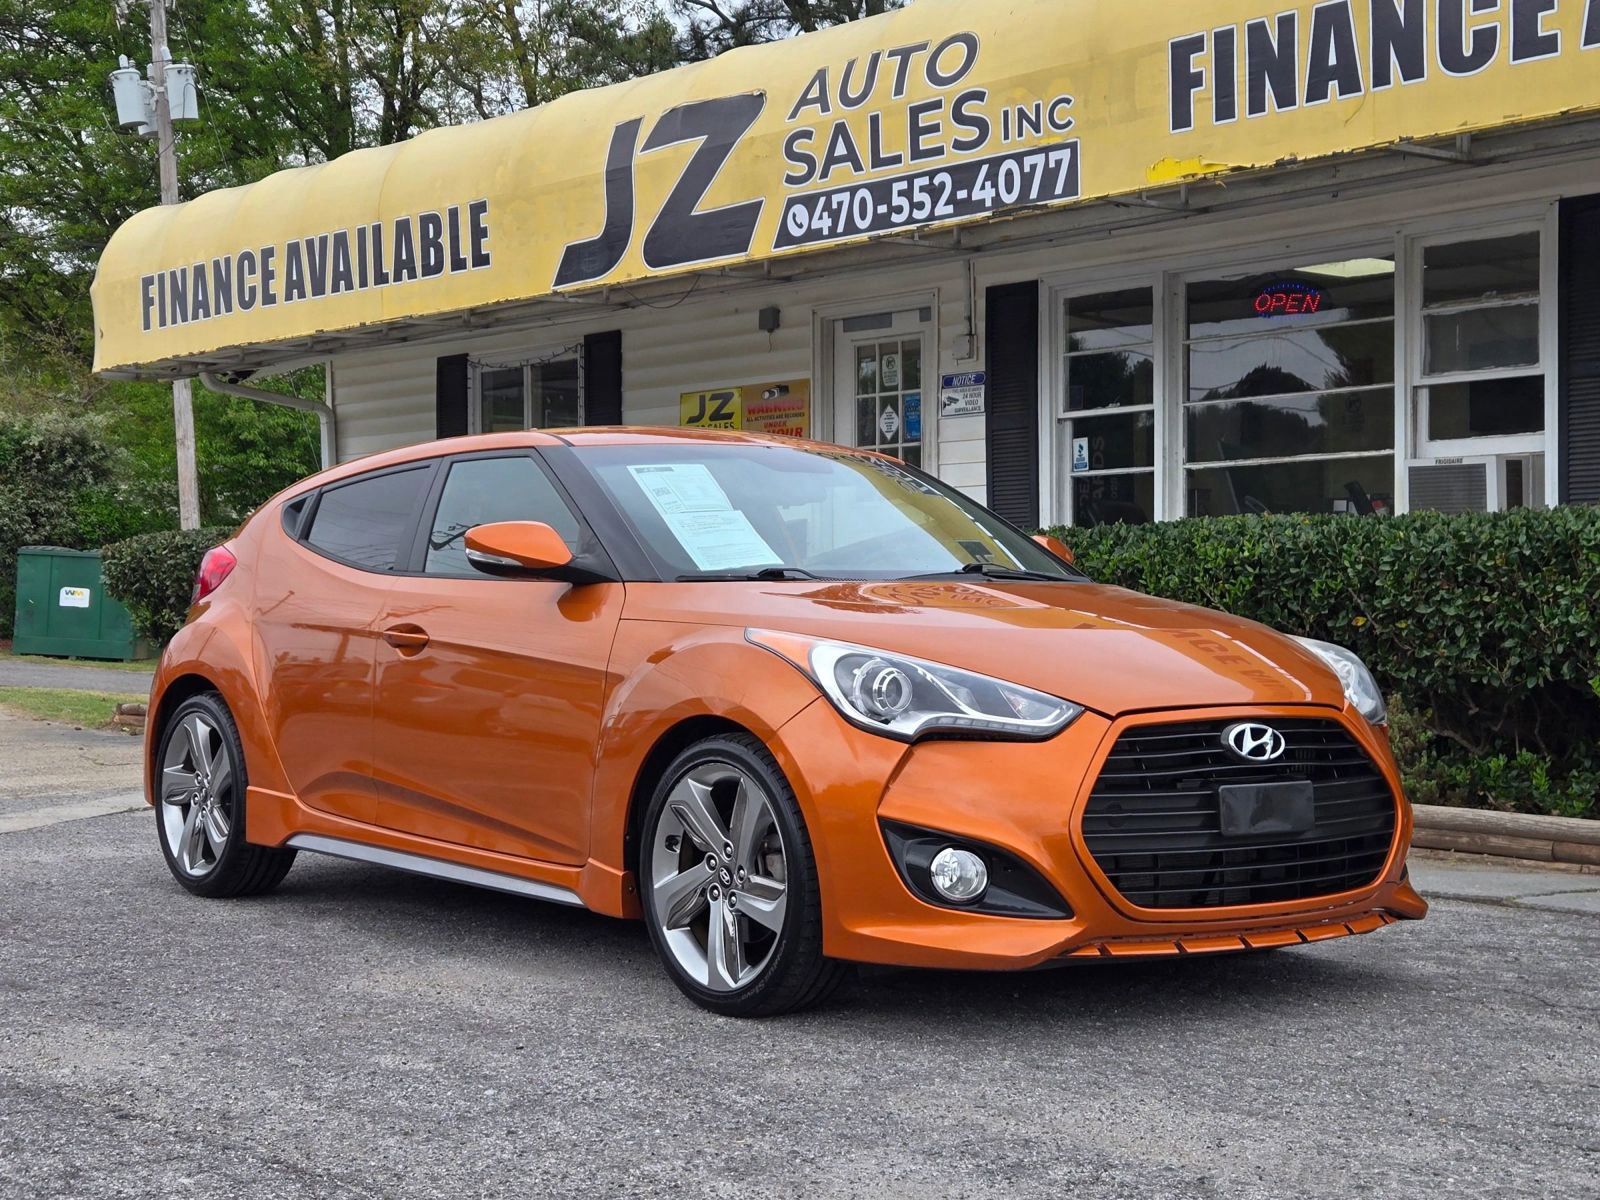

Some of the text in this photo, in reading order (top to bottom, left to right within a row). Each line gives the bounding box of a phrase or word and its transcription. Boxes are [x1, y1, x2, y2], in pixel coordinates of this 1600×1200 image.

[786, 31, 981, 122] AUTO
[1168, 0, 1562, 134] FINANCE
[782, 88, 1075, 188] SALES INC
[551, 89, 767, 290] JZ
[811, 148, 1073, 236] 470-552-4077
[141, 199, 491, 332] FINANCE AVAILABLE
[1254, 292, 1320, 313] OPEN
[686, 391, 735, 424] JZ
[952, 374, 976, 386] NOTICE
[969, 391, 982, 399] HOUR
